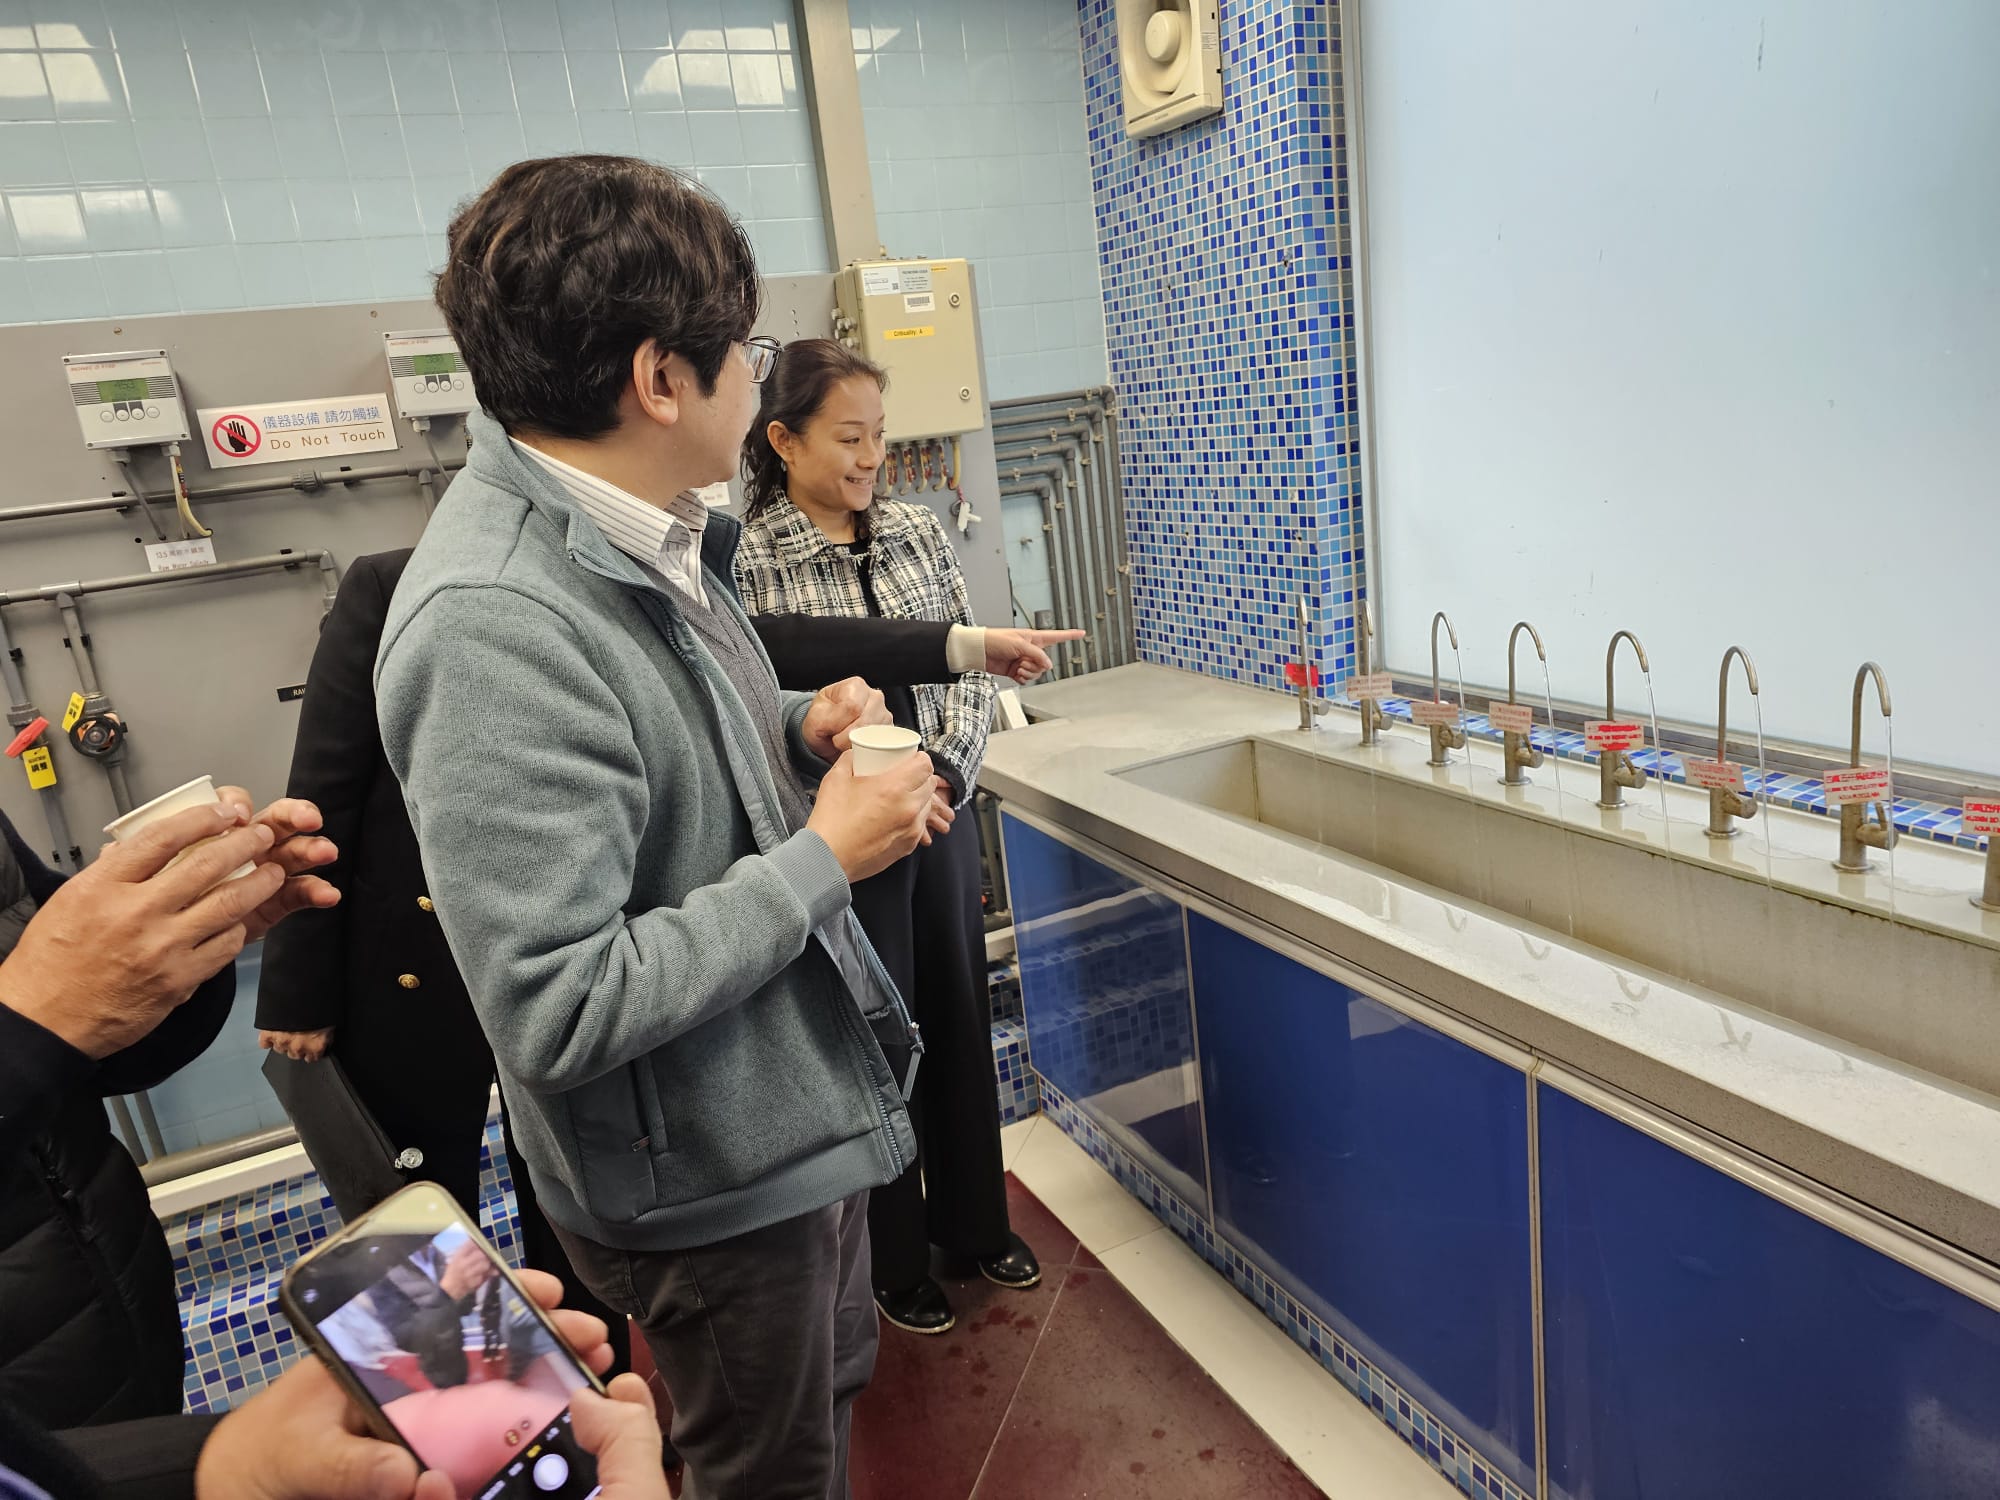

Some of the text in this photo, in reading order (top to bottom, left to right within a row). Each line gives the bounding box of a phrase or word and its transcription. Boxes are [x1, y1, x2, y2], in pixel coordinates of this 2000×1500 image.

[262, 406, 382, 430] 儀器設備 請勿觸摸
[270, 429, 386, 450] Do Not Touch
